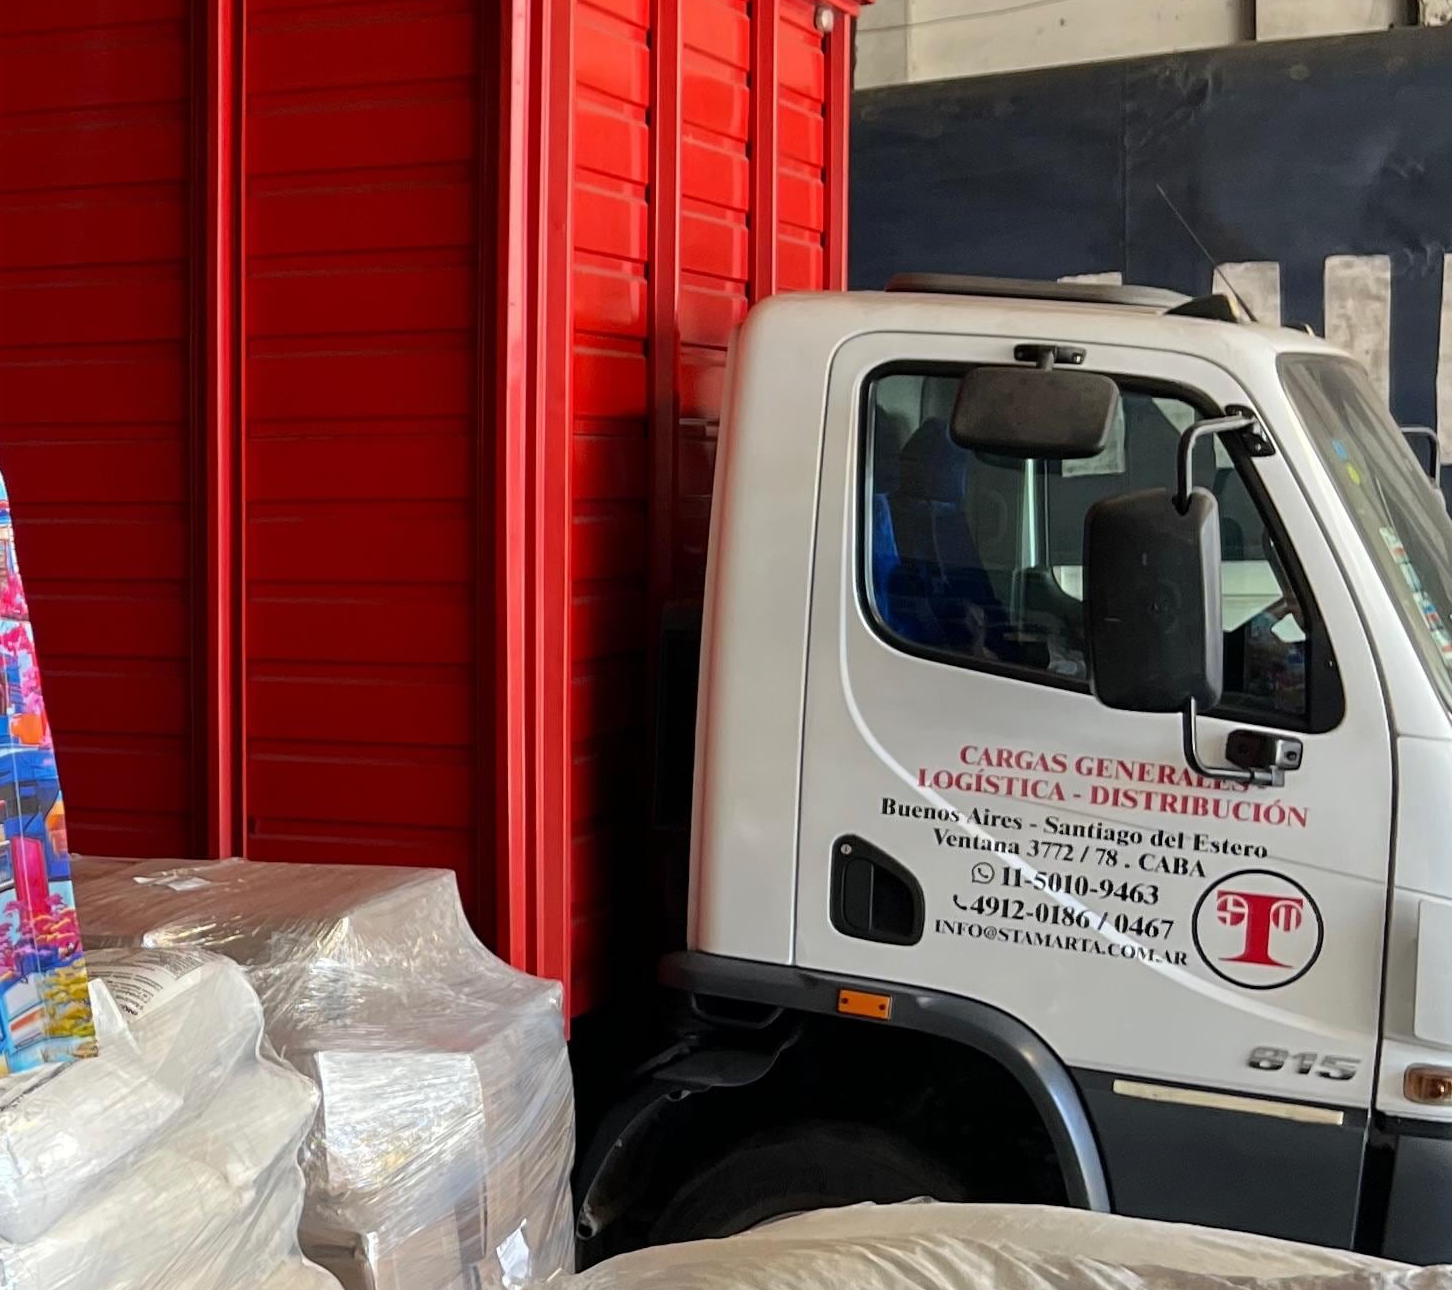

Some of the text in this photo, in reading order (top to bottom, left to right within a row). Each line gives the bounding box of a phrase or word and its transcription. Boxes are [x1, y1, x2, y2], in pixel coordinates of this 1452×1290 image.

[959, 744, 1068, 774] CARGAS
[917, 767, 1066, 802] LOGÍSTICA
[1090, 784, 1309, 828] DISTRIBUCIÓN
[880, 797, 960, 822] Buenos
[966, 807, 1023, 831] Aires
[1043, 815, 1143, 847] Santiago
[1150, 829, 1185, 850] del
[1193, 833, 1269, 860] Estero
[933, 827, 1020, 855] Ventana
[1026, 839, 1074, 862] 3772
[1094, 848, 1118, 868] 78
[1138, 852, 1206, 878] CABA
[1001, 866, 1160, 906] 11-5010-9463
[970, 895, 1091, 930] 4912-0186
[1113, 913, 1175, 940] 0467
[934, 918, 1188, 967] INFO@STAMARTA.COM.AR
